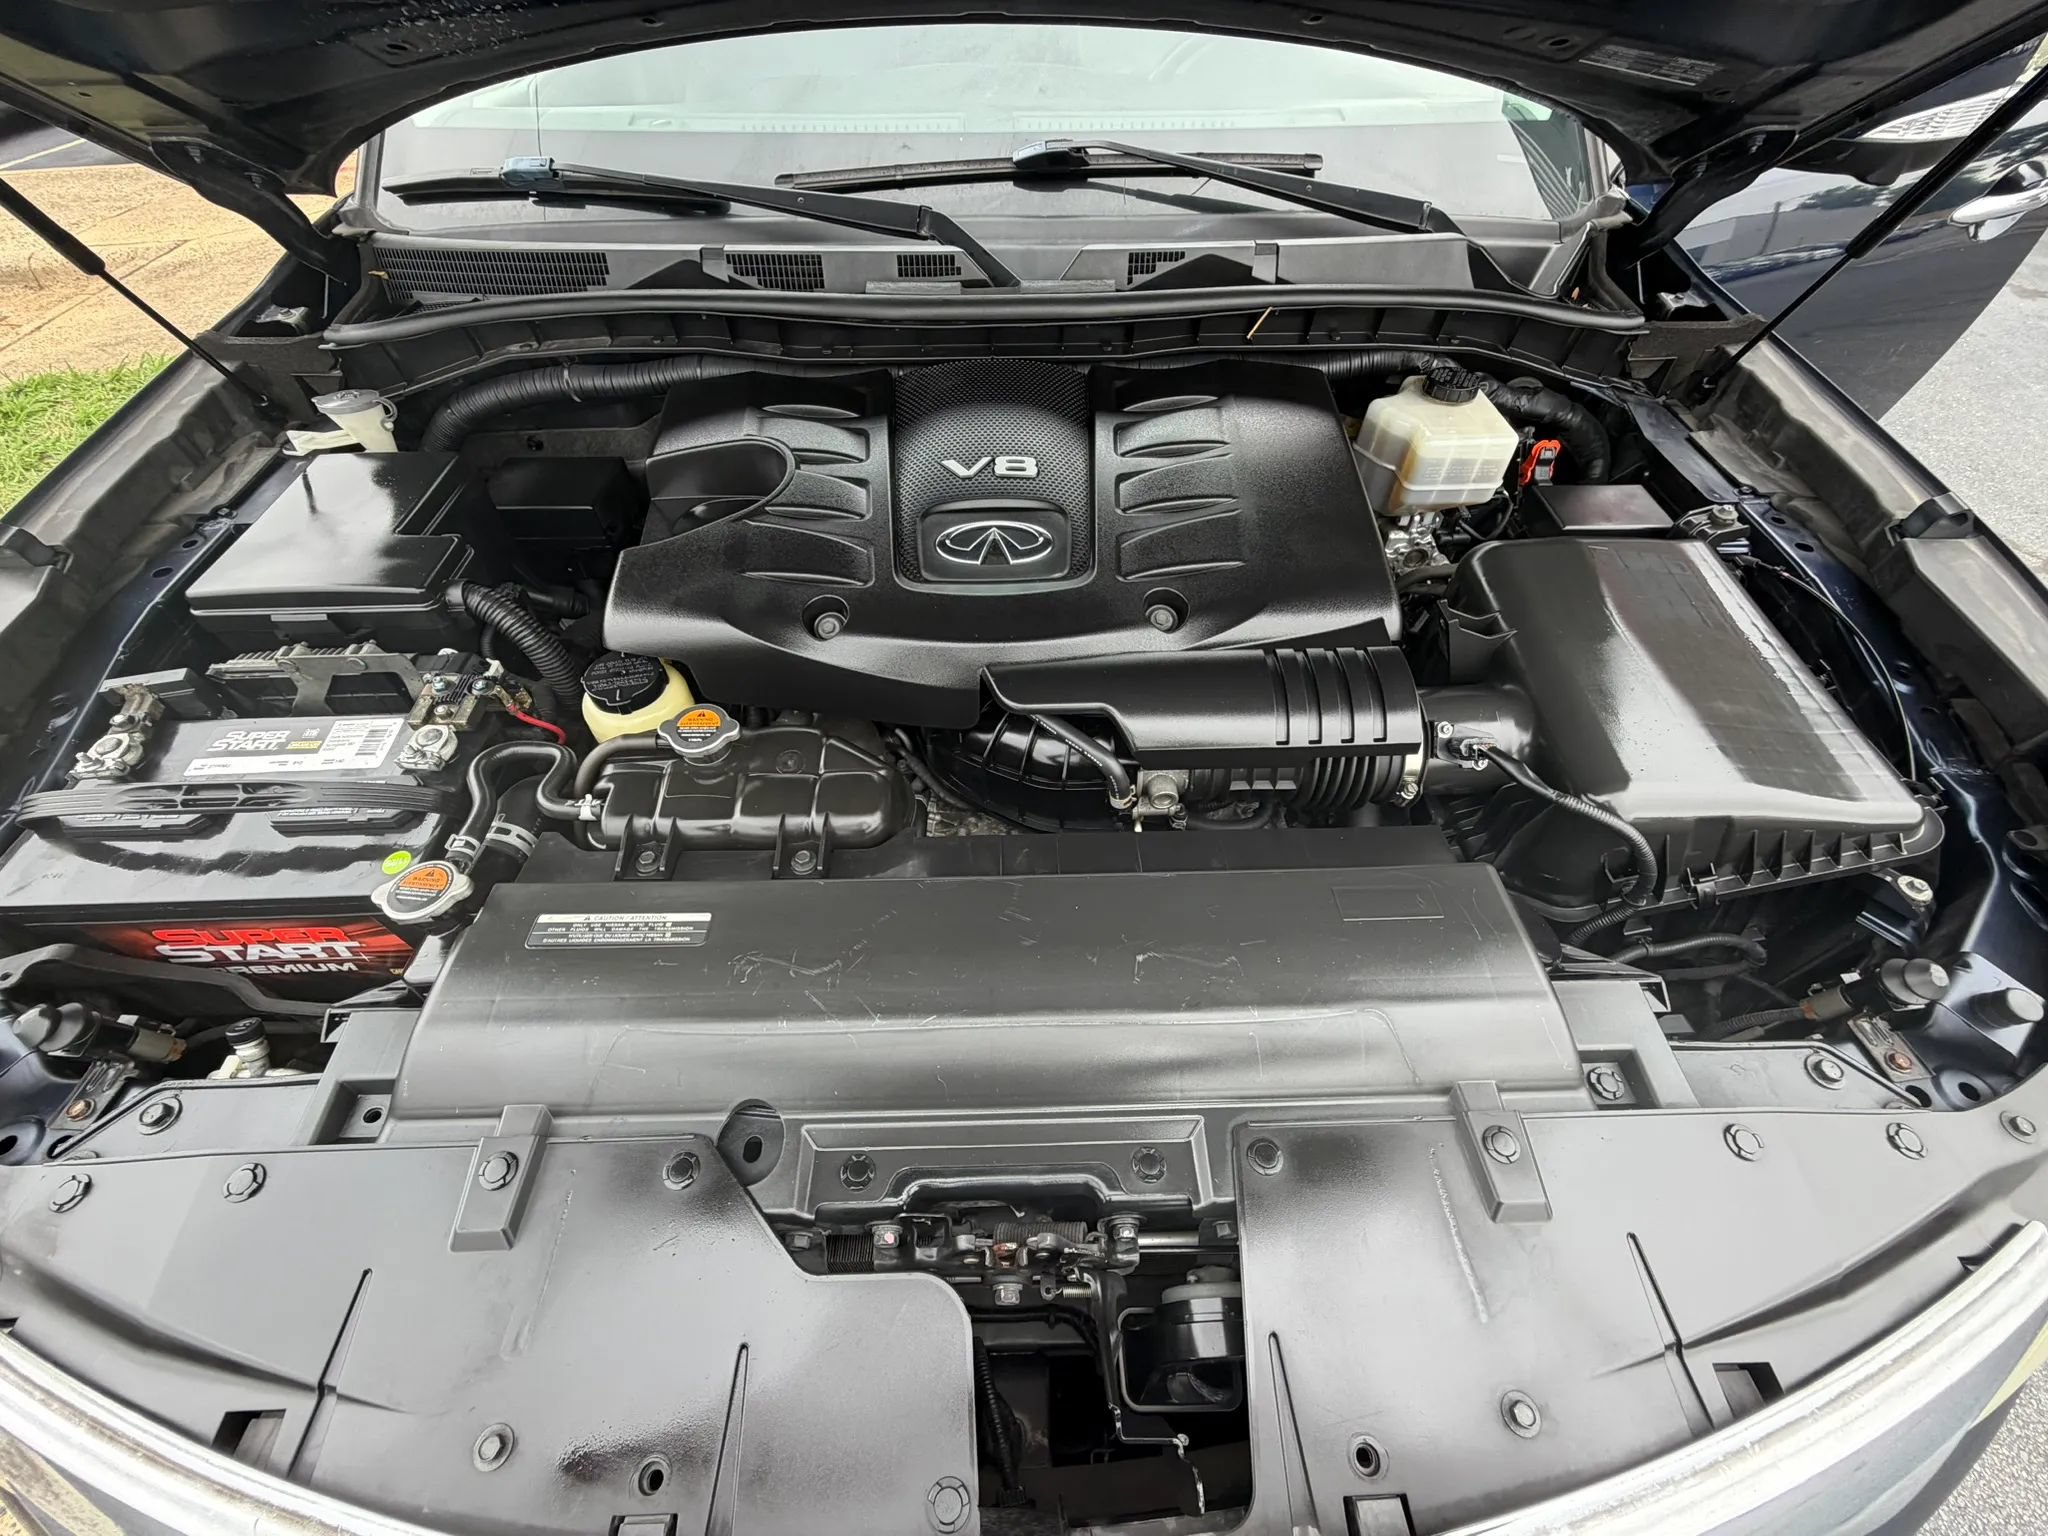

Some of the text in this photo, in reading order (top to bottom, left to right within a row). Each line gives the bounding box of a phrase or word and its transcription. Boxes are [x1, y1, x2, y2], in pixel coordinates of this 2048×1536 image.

[941, 456, 1039, 478] V8
[225, 730, 291, 741] SUPER
[206, 739, 288, 752] START
[151, 927, 351, 946] SUPER
[155, 941, 361, 963] START
